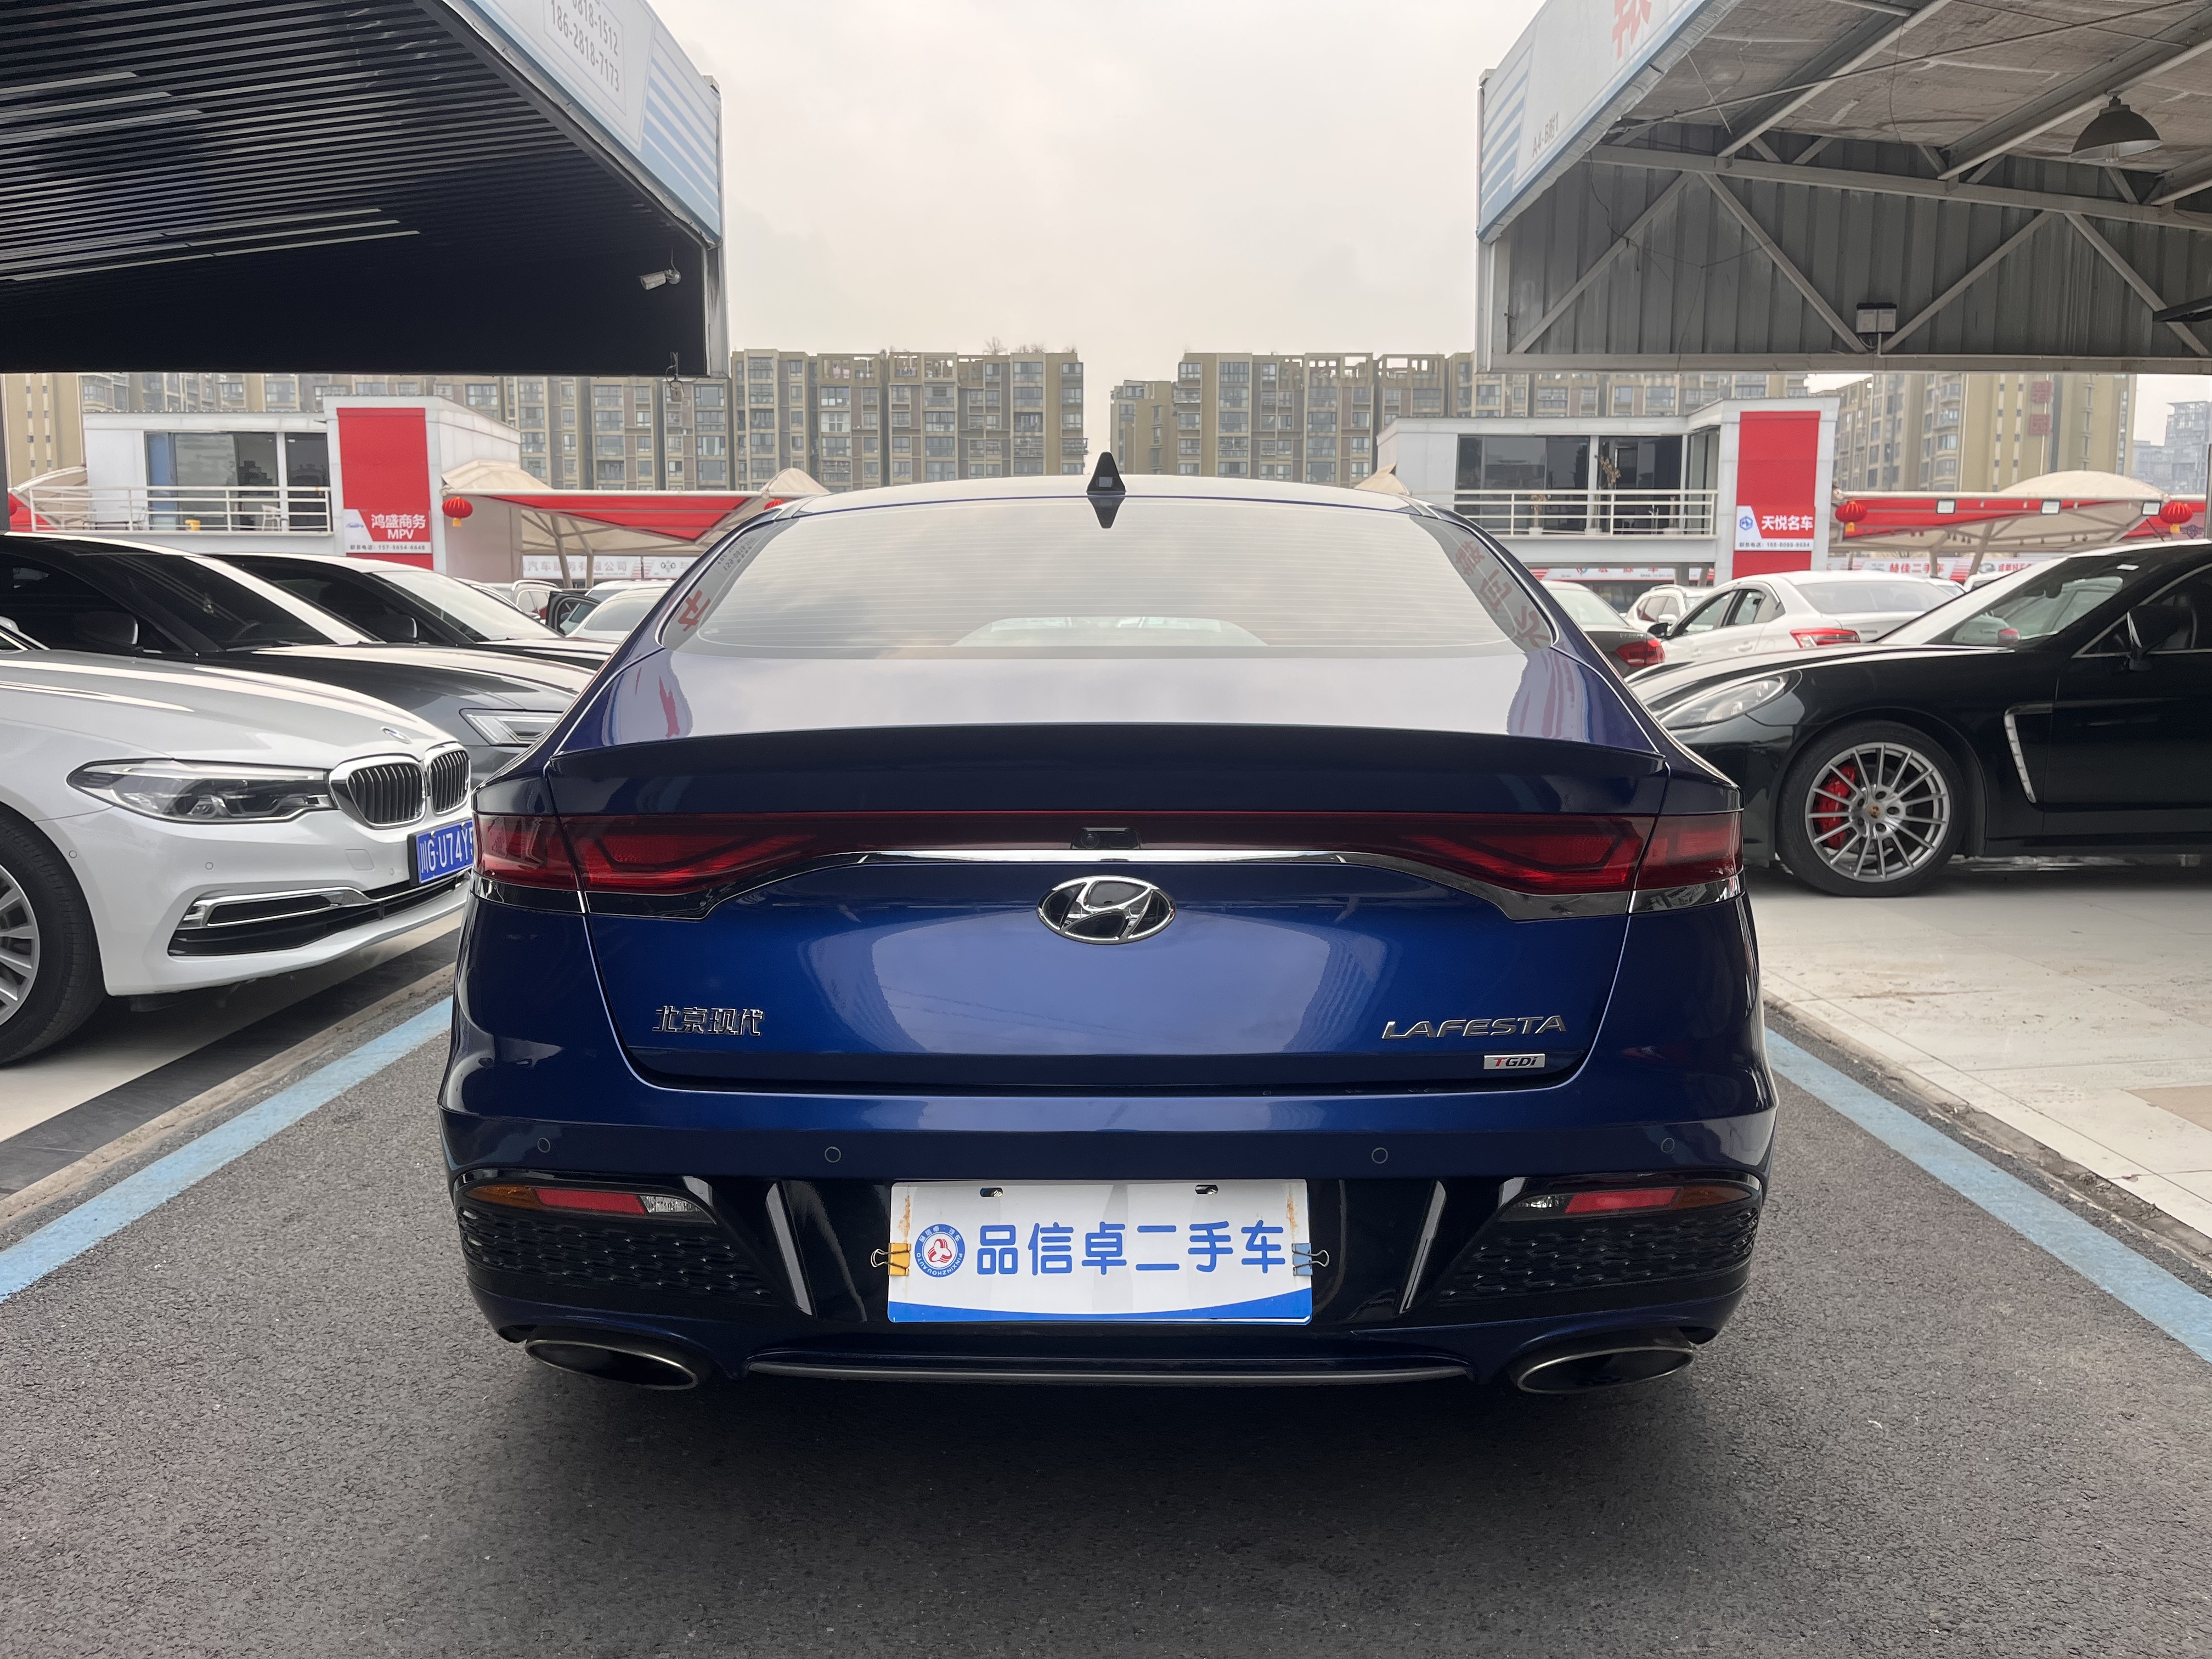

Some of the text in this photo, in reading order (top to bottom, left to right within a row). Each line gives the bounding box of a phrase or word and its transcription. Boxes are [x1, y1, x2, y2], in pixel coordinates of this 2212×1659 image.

[551, 0, 619, 92] 186-2818-7173
[370, 514, 426, 529] 鸿盛商务
[1761, 515, 1814, 531] 天悦名车
[387, 529, 414, 539] MPV
[652, 1005, 764, 1036] 北京现代
[1381, 1015, 1566, 1040] LAFESTA
[1493, 1056, 1538, 1068] TGDi
[976, 1220, 1286, 1276] 品信卓二手车
